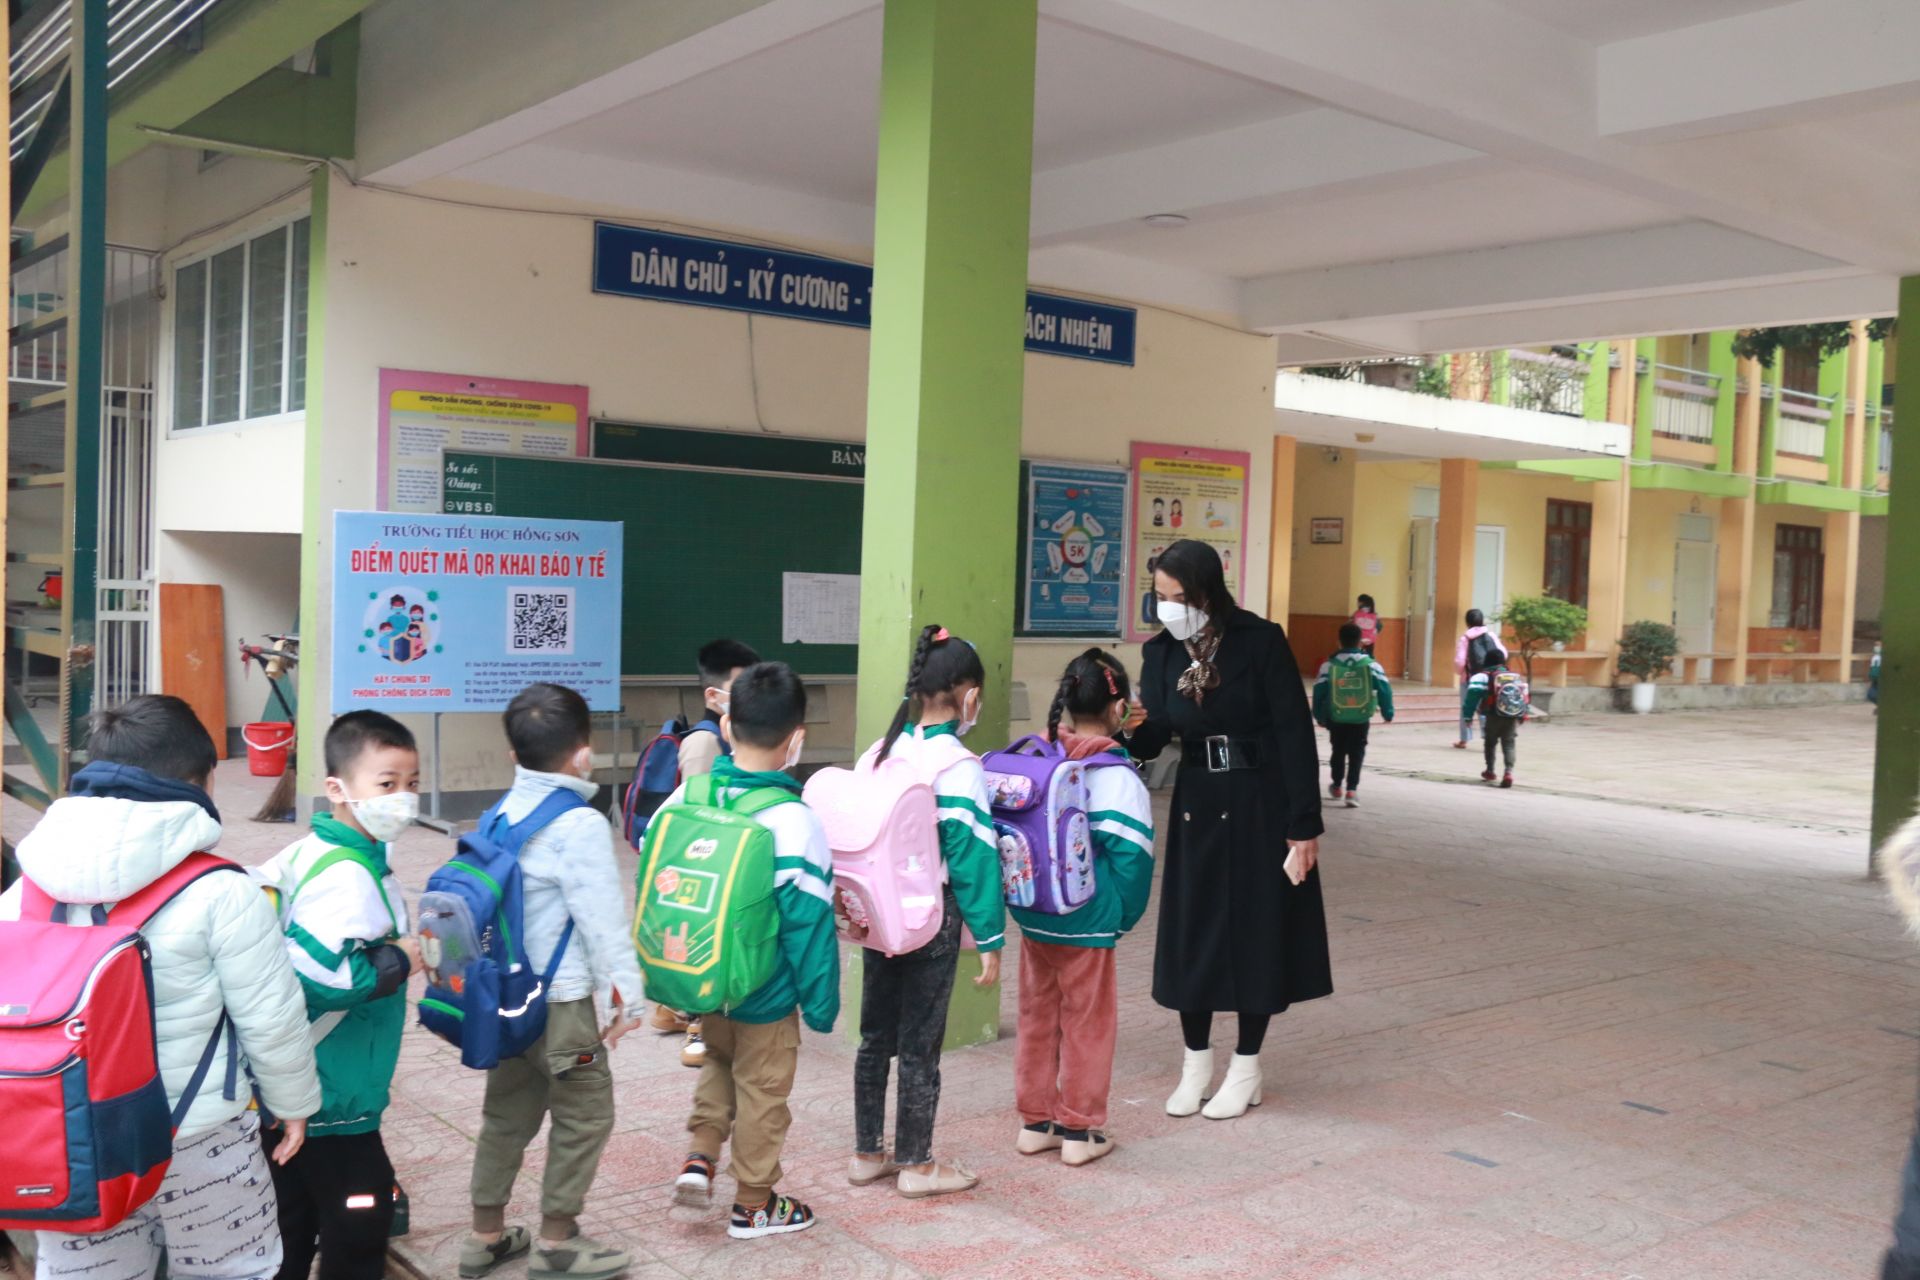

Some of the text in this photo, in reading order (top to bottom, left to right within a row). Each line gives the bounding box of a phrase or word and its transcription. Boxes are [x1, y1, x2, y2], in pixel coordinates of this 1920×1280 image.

[631, 247, 677, 288] DÂN
[684, 250, 728, 294] CHỦ
[748, 258, 775, 301] KỶ
[781, 273, 849, 312] CƯƠNG
[1024, 305, 1057, 343] ÁCH
[1060, 316, 1113, 354] NHIỆM
[831, 446, 866, 466] BẢN
[382, 524, 441, 538] TRƯỜNG
[480, 528, 510, 541] HỌC
[554, 530, 580, 541] SƠN
[351, 540, 607, 577] ĐIỂM QUÉT MÃ QR KHAI BÁO Y TẾ
[1070, 546, 1085, 558] 5K
[154, 1161, 252, 1205] Champio
